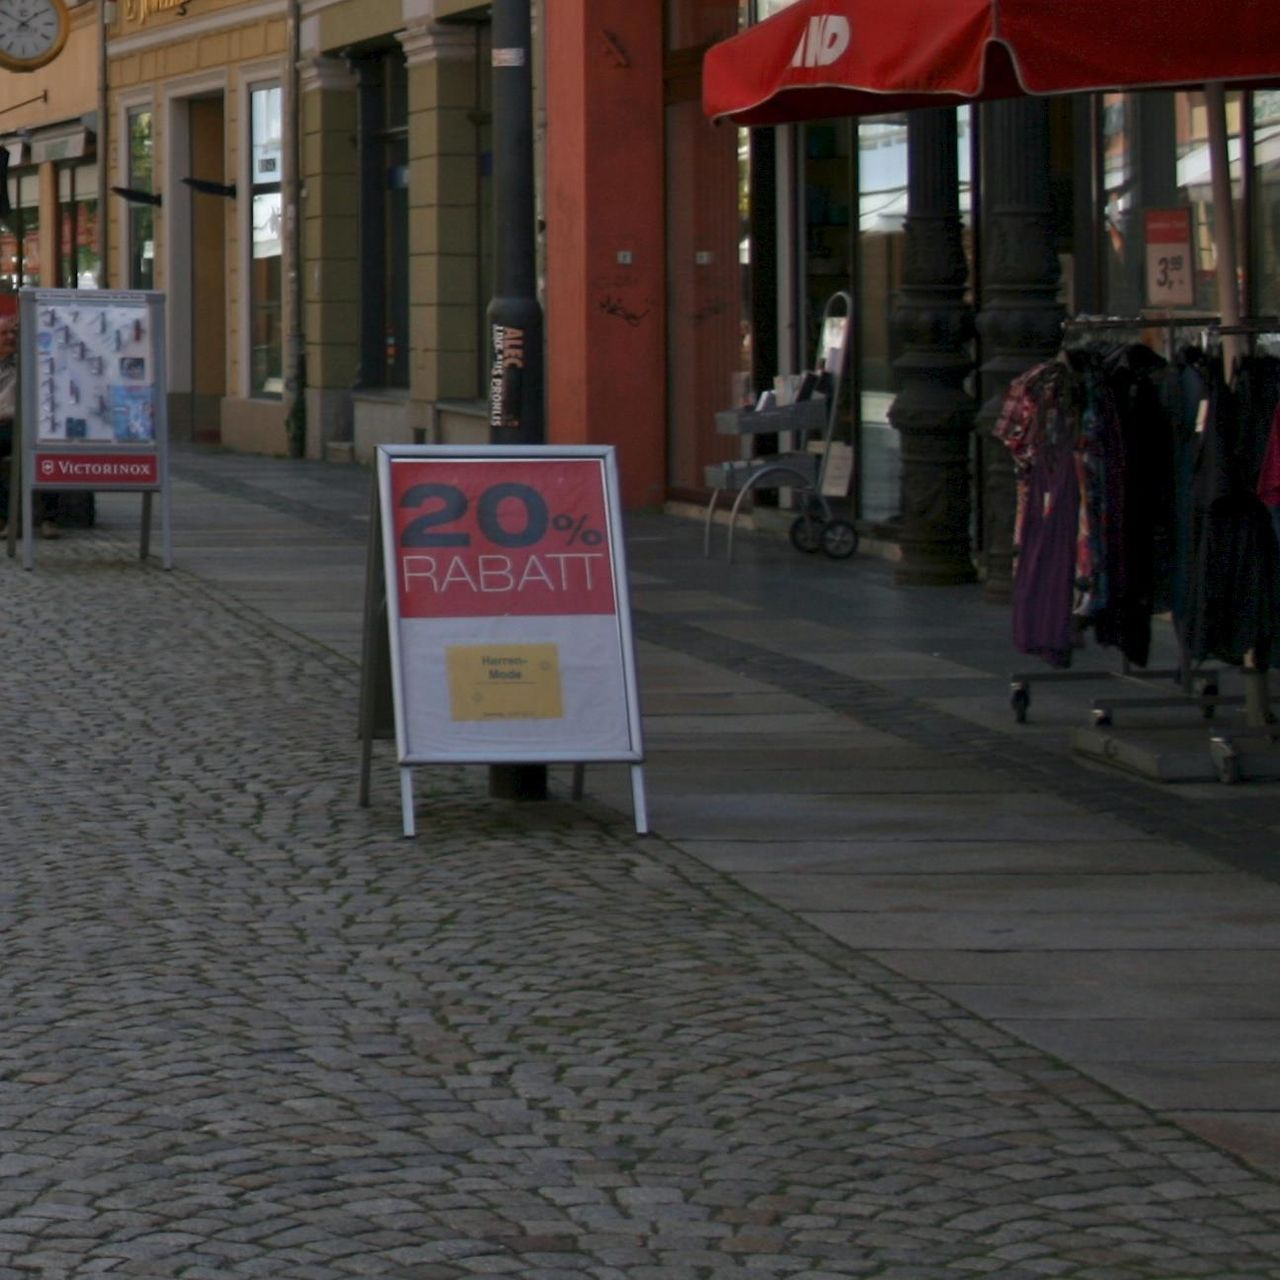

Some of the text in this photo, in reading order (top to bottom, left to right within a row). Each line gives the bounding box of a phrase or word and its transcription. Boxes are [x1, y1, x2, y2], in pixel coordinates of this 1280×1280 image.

[502, 325, 525, 369] ALEC
[58, 460, 151, 475] VICTORINOX
[399, 481, 604, 549] 20%
[402, 552, 604, 593] RABATT
[488, 669, 523, 680] Mode
